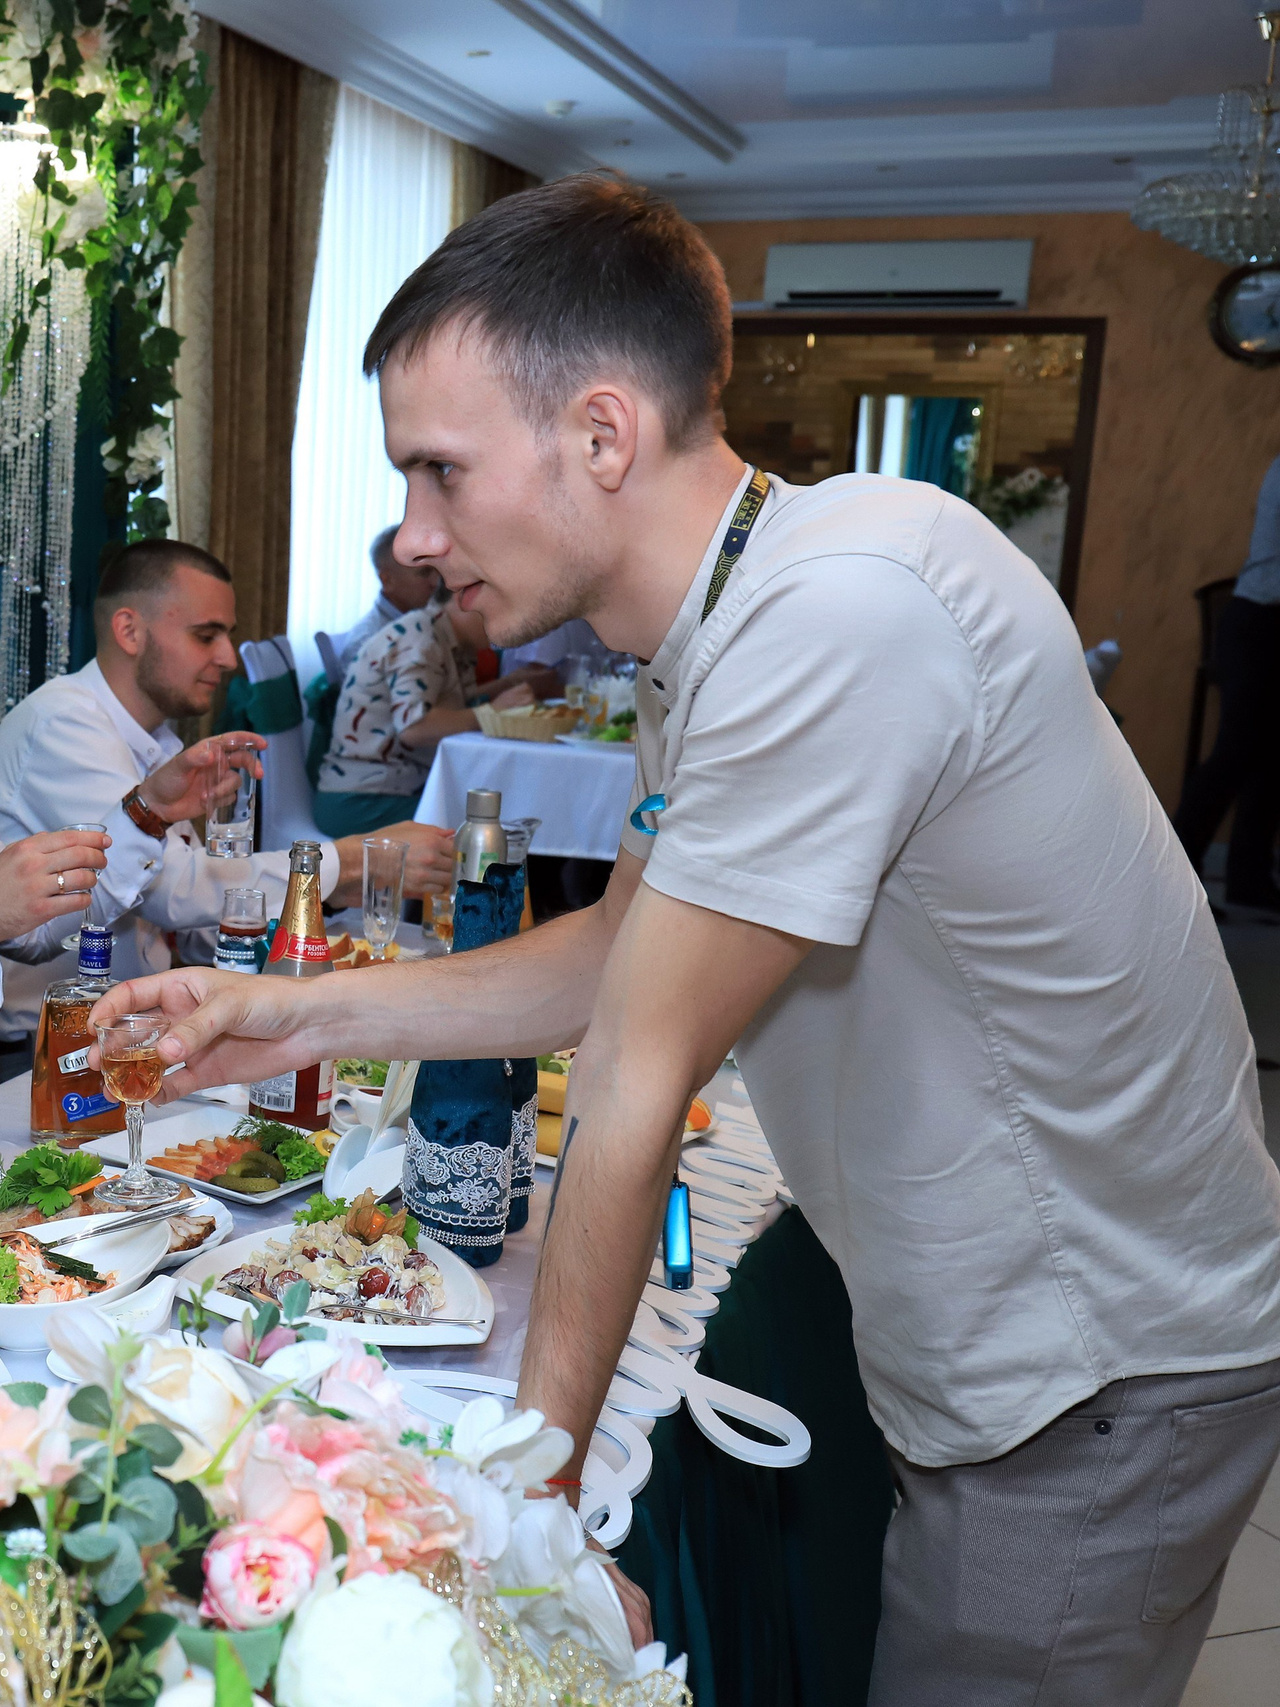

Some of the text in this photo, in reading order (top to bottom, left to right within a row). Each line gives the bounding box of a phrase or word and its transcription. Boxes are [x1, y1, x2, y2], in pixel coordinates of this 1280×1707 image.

[80, 960, 102, 968] TRAVEL
[63, 1055, 88, 1070] СТАР
[68, 1096, 79, 1112] 3
